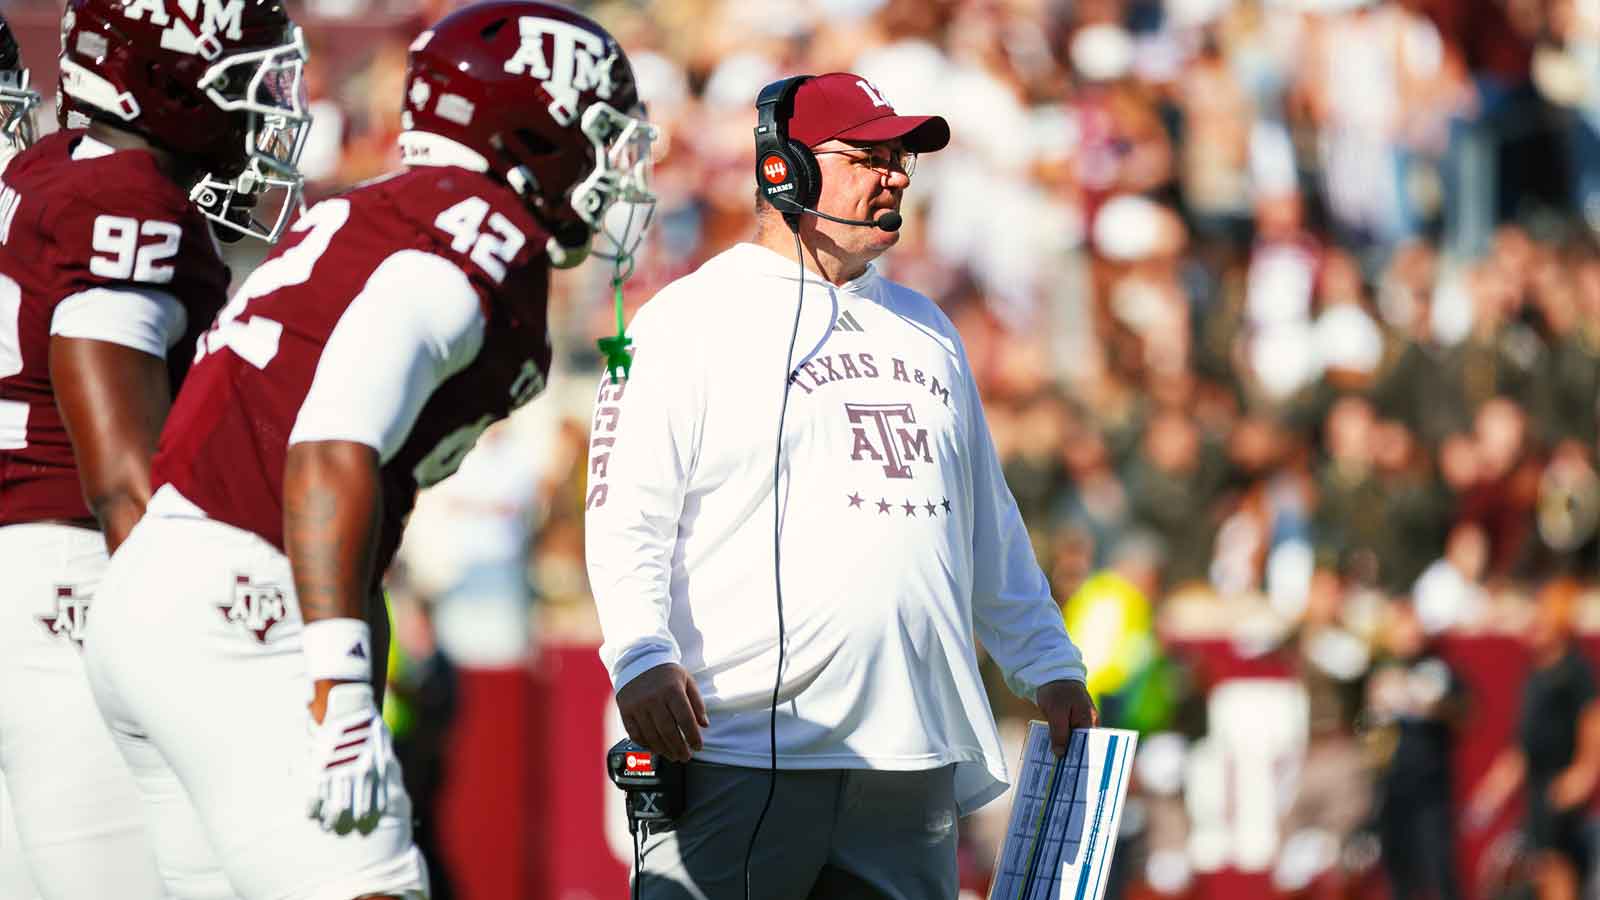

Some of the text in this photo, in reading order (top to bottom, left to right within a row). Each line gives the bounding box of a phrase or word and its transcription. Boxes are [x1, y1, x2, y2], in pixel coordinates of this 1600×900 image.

[764, 162, 786, 178] 44
[767, 183, 794, 195] FARMS
[89, 214, 182, 284] 92
[433, 196, 526, 284] 42
[193, 198, 351, 370] 2
[789, 353, 879, 395] TEXAS
[844, 402, 935, 479] ATM
